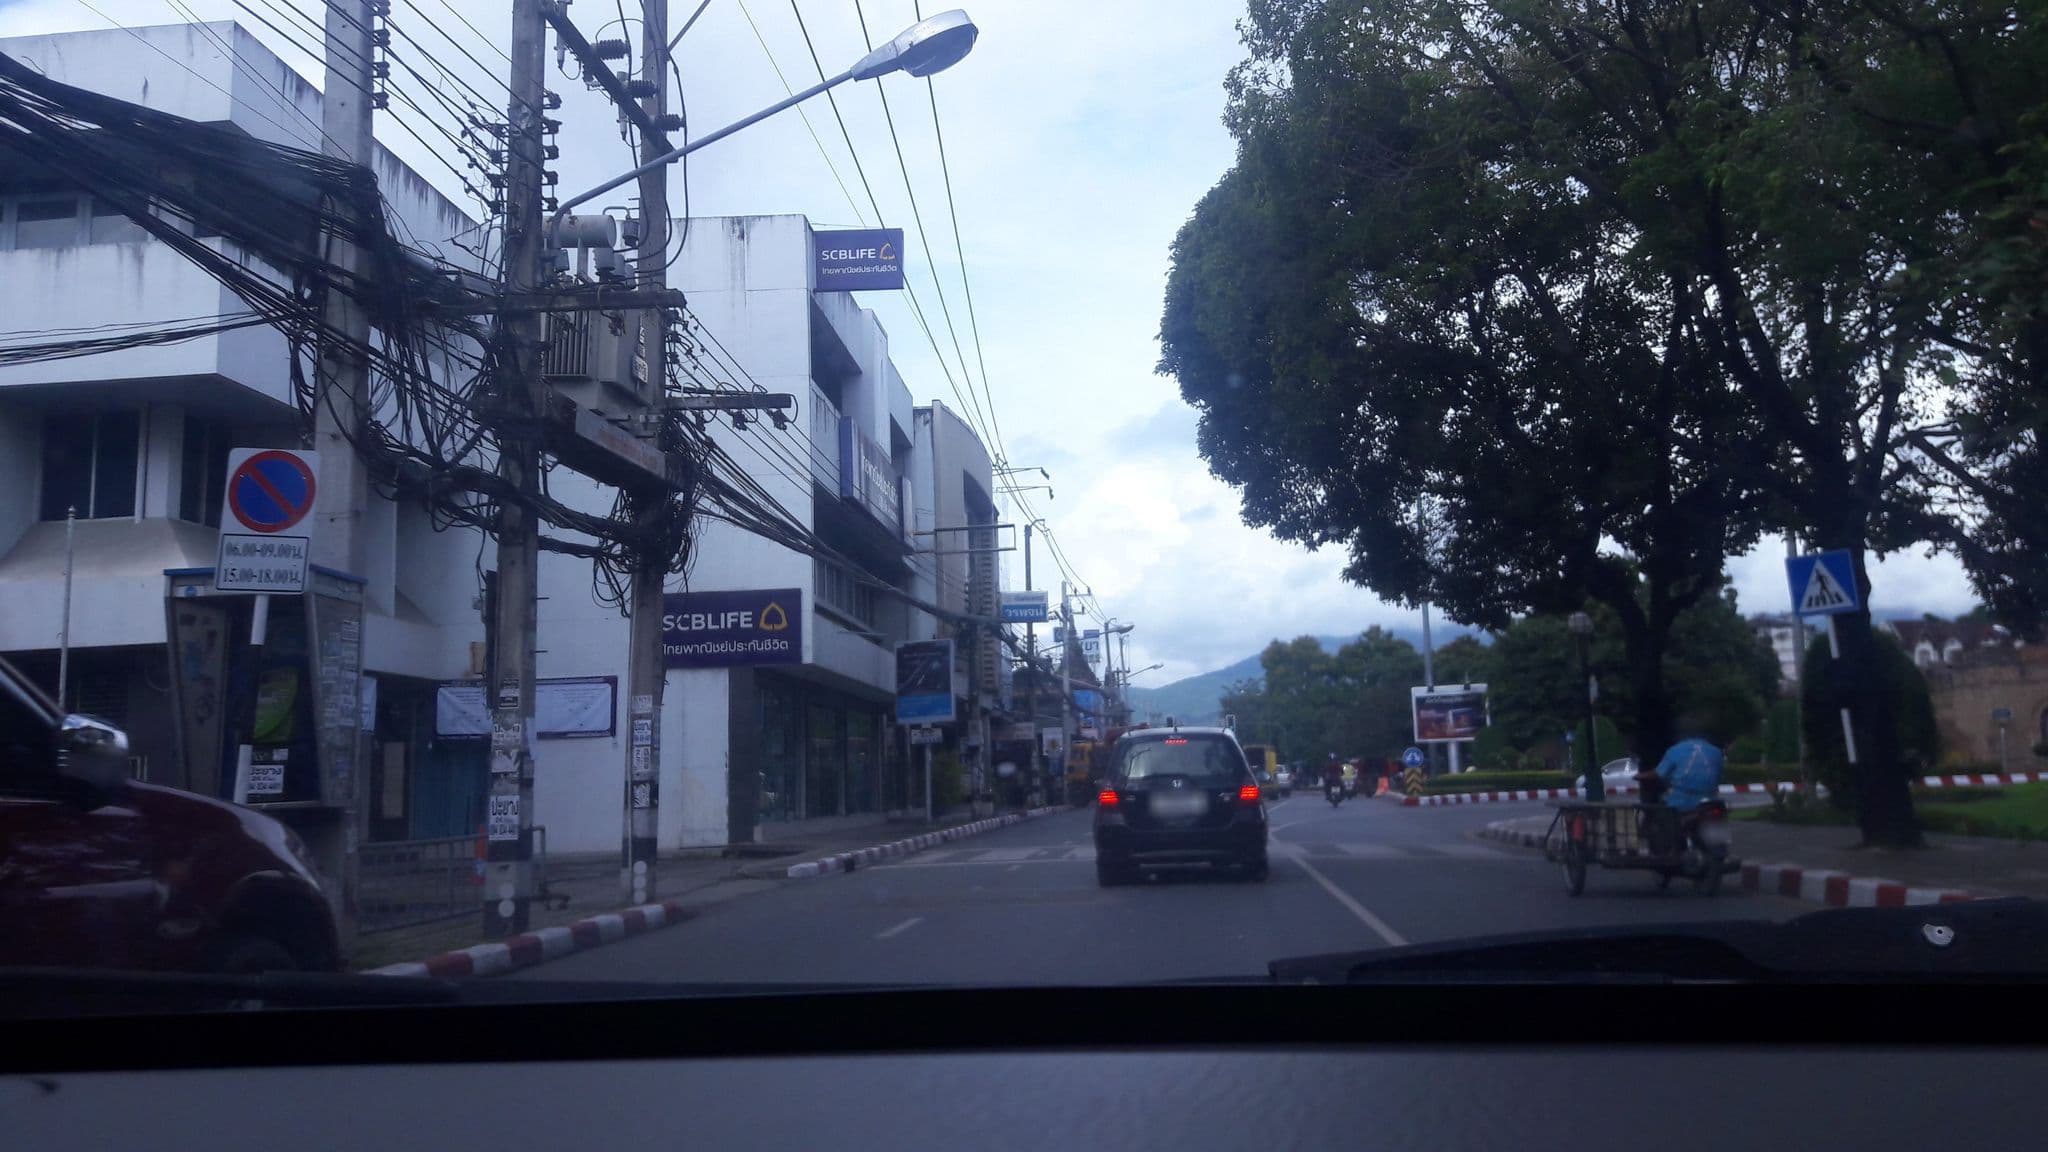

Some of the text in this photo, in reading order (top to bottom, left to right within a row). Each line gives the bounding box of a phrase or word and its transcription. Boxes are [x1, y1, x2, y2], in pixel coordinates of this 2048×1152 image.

[821, 248, 876, 260] SCBLIFE
[662, 611, 753, 631] SCBLIFE
[663, 638, 789, 656] ไทยพาณิชย์ประกันชีวิต
